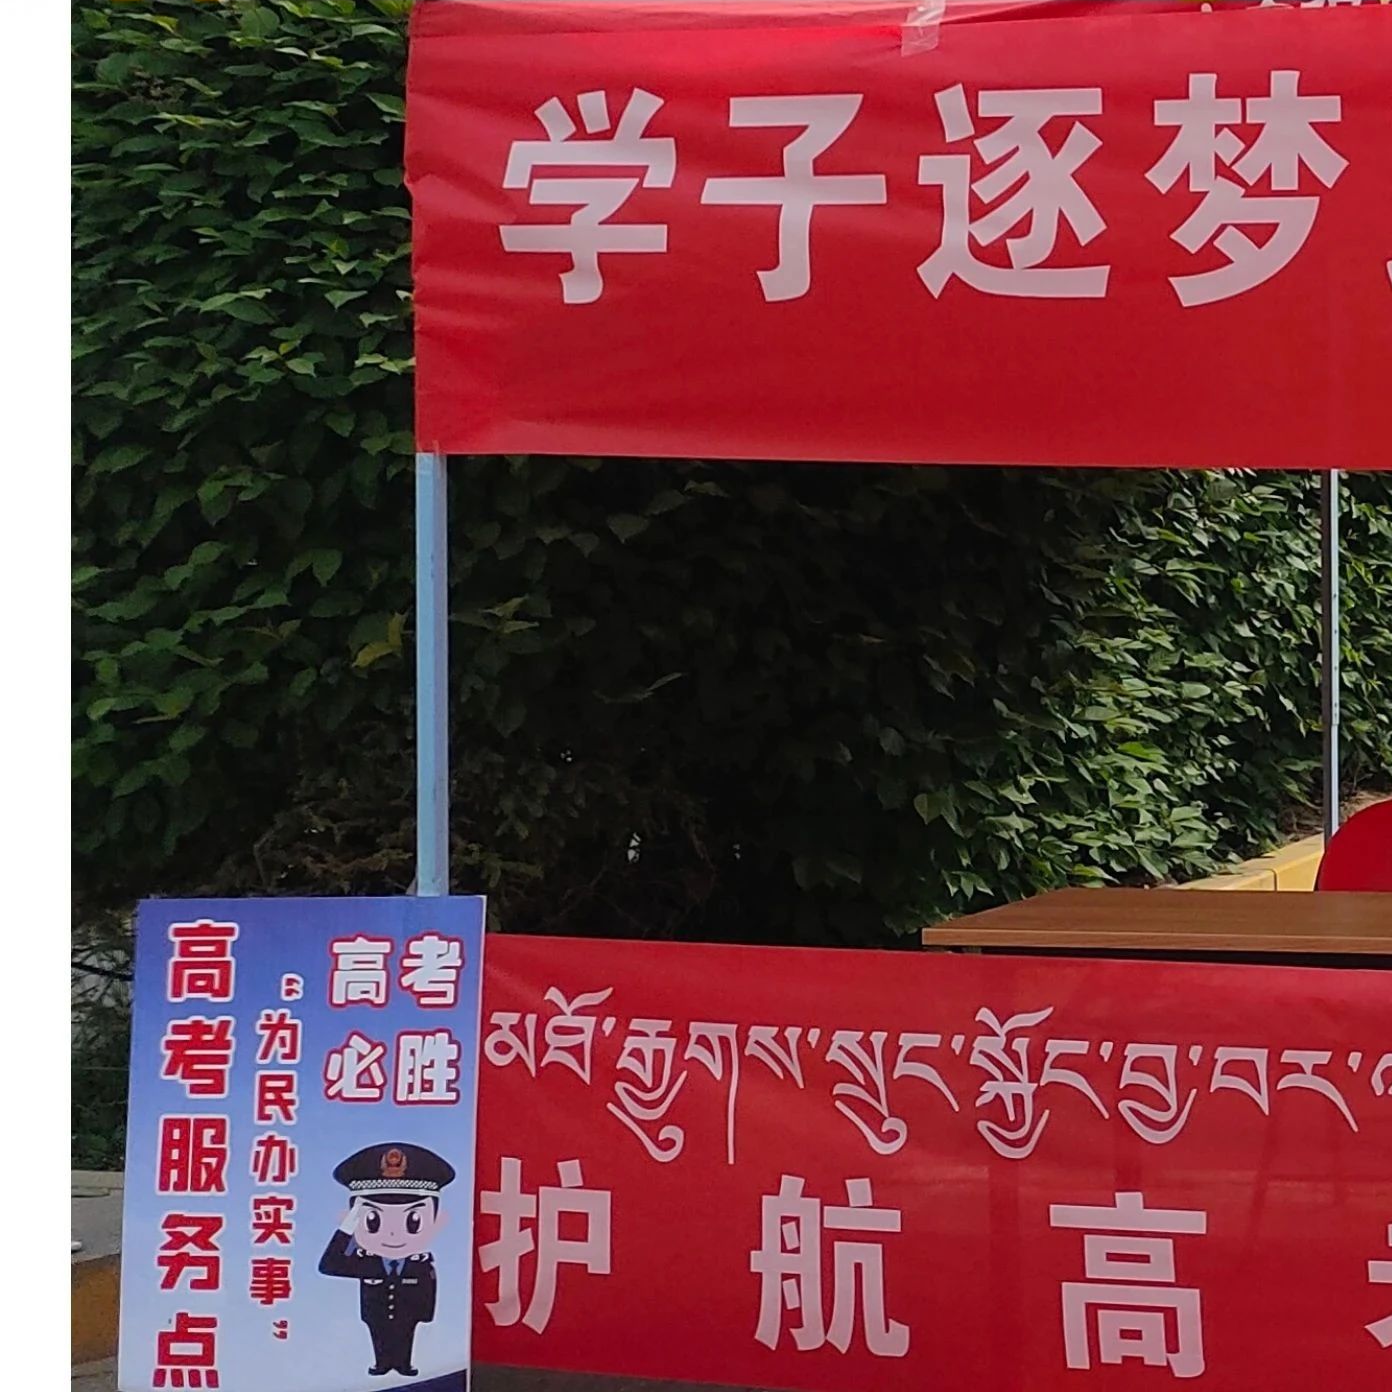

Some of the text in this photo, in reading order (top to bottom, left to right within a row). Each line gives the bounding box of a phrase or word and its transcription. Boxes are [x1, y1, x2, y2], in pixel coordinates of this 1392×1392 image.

[329, 933, 463, 1008] 高考
[325, 1030, 460, 1105] 必胜
[153, 921, 239, 1390] 高考服务点
